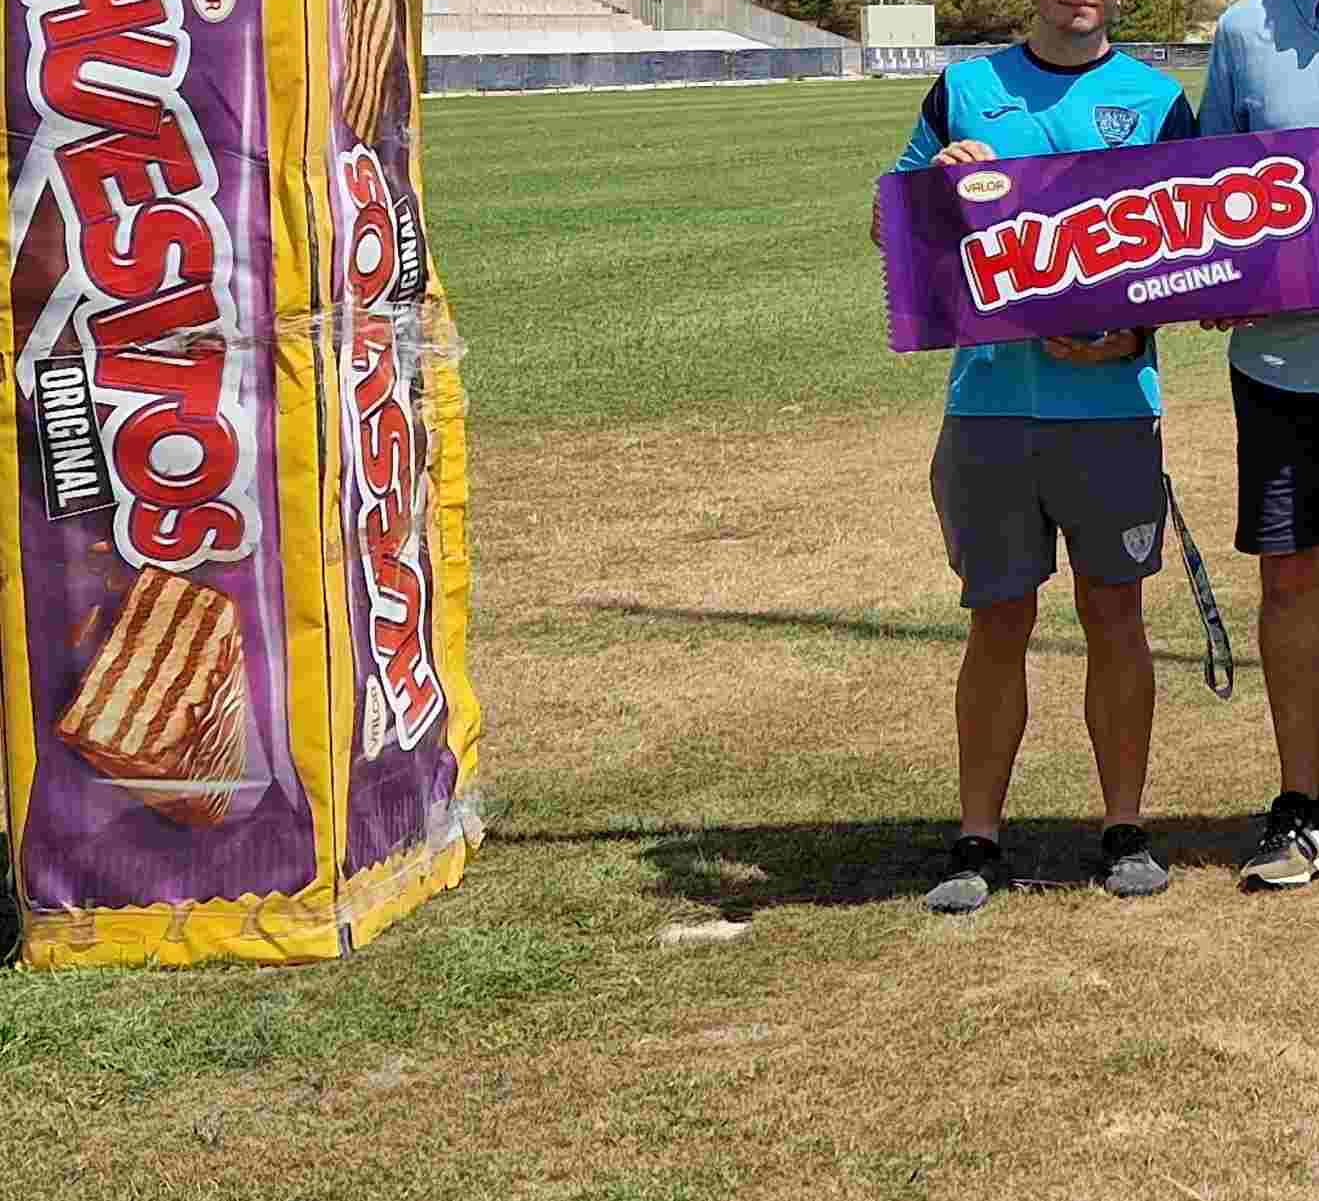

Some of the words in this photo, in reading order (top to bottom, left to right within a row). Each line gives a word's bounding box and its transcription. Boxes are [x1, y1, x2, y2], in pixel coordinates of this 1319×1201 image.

[962, 160, 1309, 305] HUESITOS
[963, 180, 1004, 192] VALOR
[1126, 259, 1242, 304] ORIGINAL
[38, 366, 101, 507] ORIGINAL
